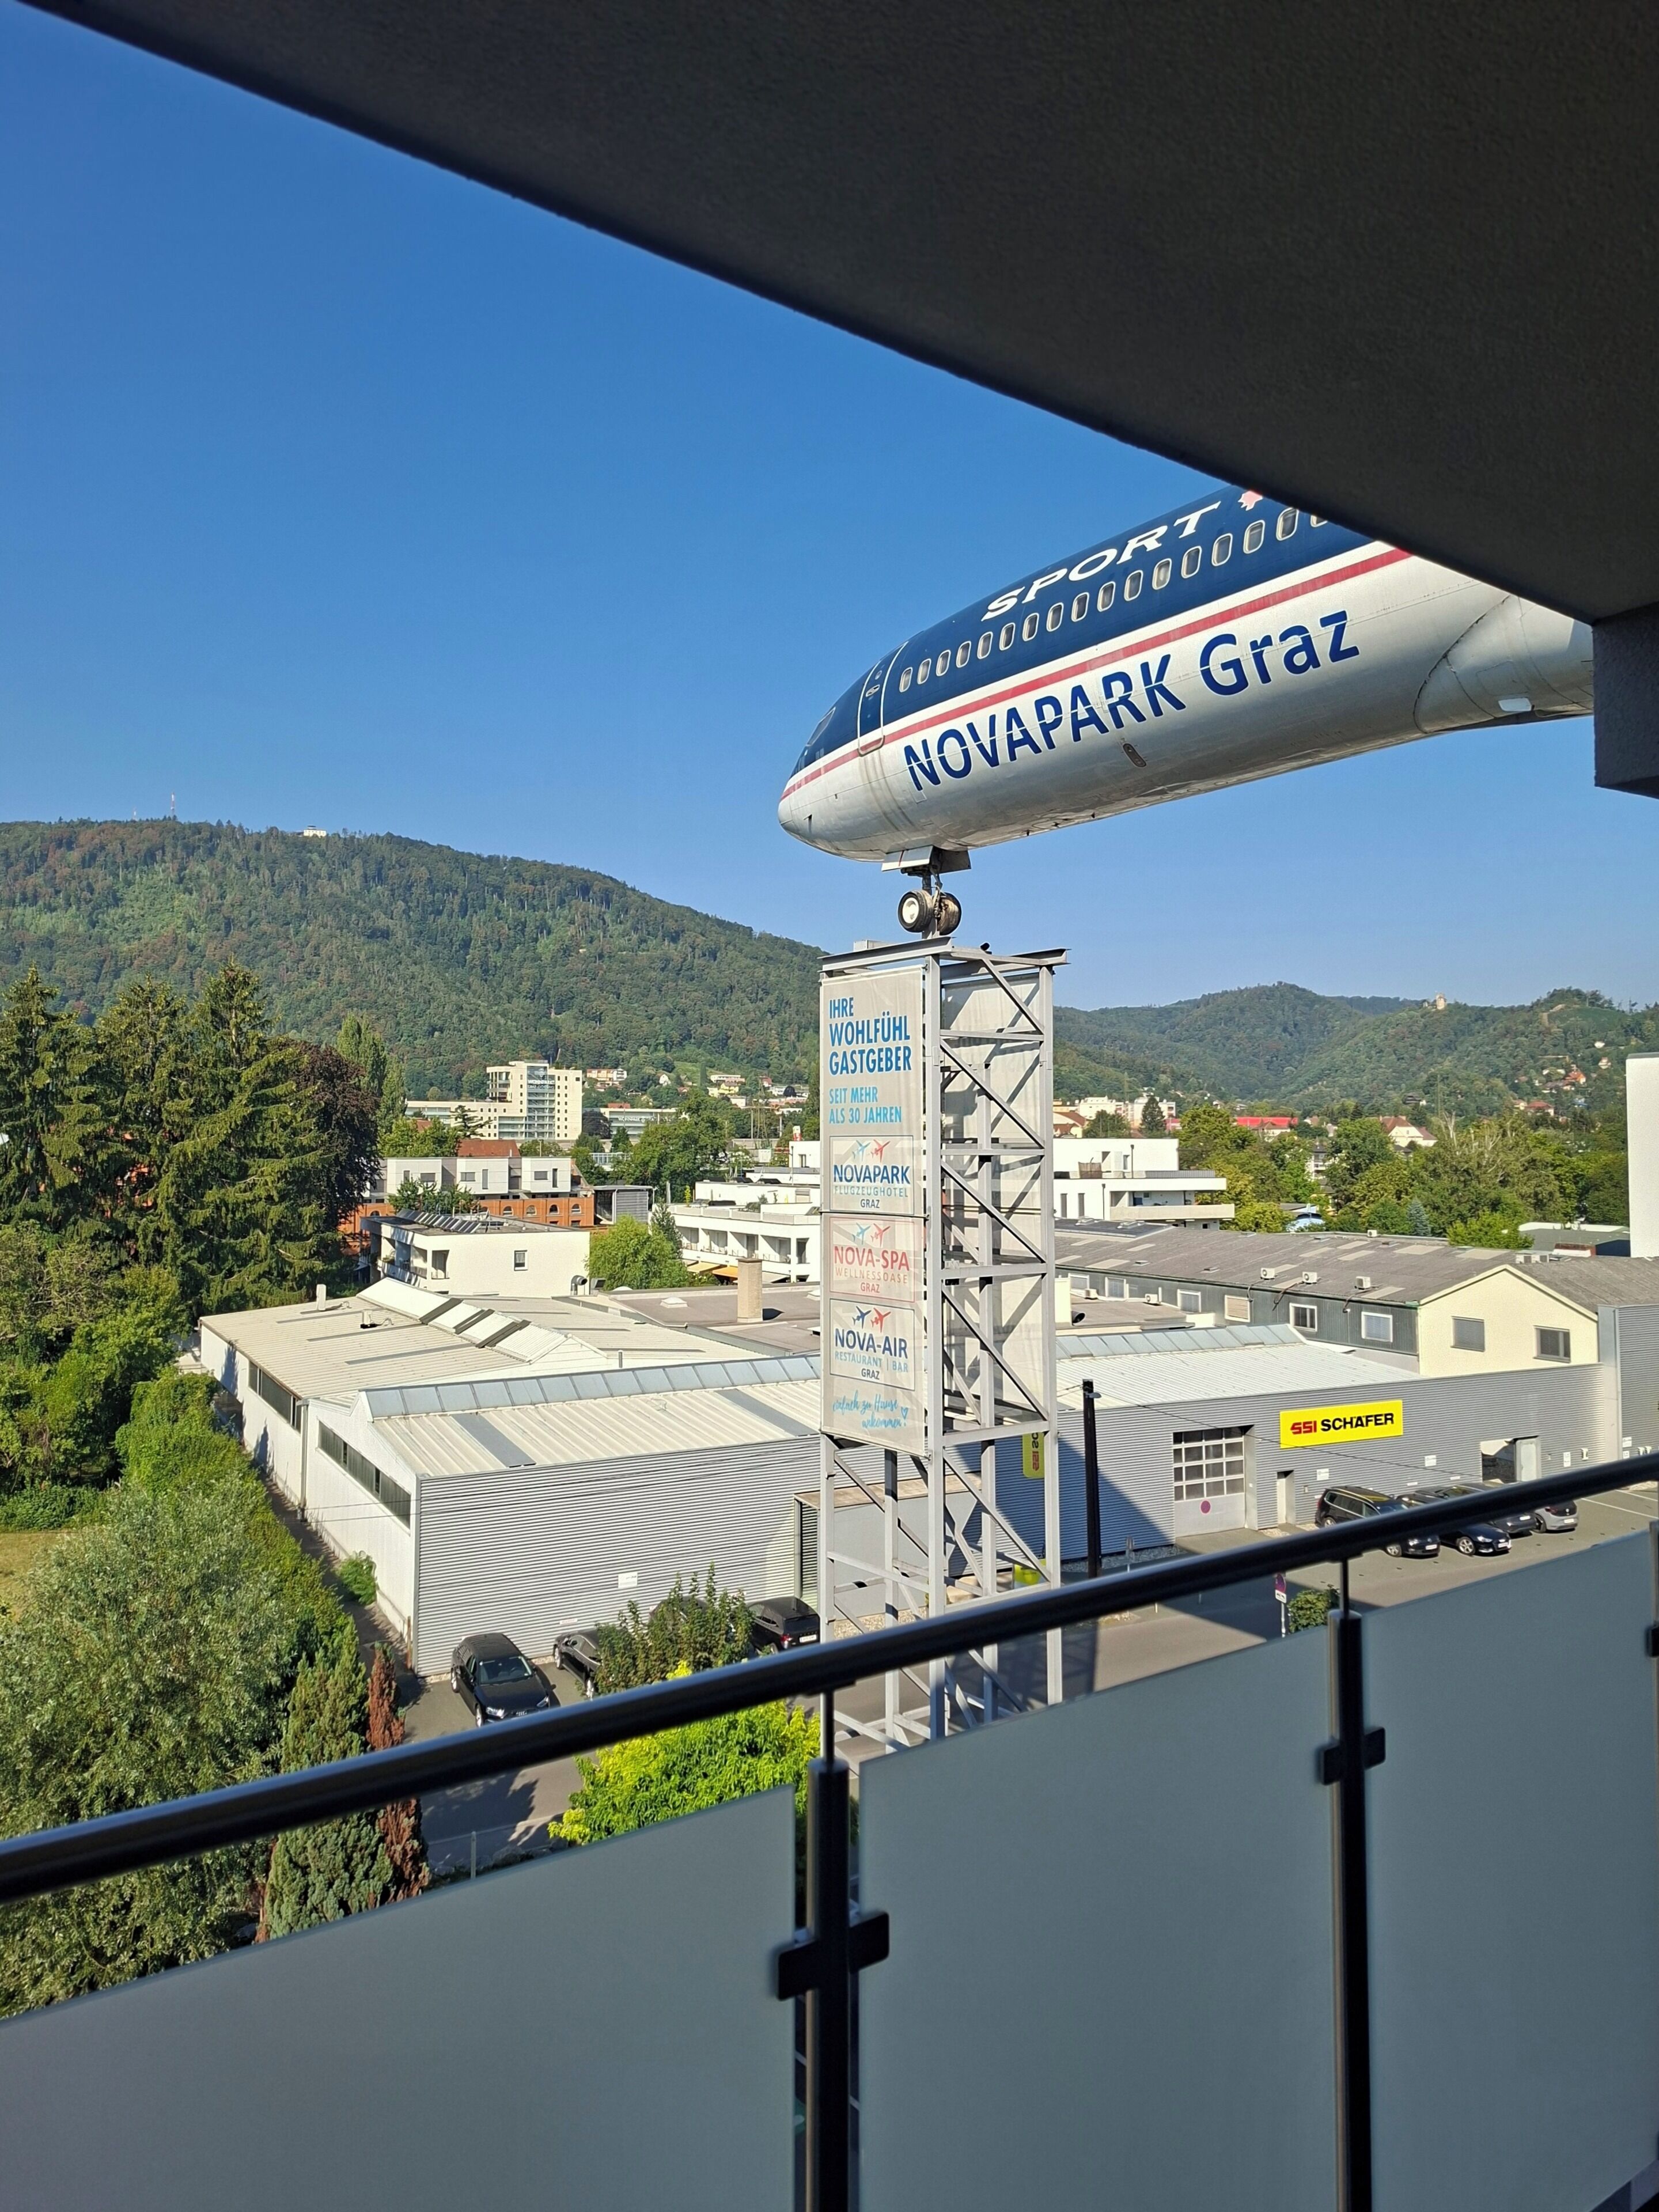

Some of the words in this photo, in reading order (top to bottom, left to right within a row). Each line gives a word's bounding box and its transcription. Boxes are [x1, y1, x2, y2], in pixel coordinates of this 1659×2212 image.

[981, 501, 1221, 622] SPORT
[904, 654, 1187, 791] NOVAPARK
[1200, 610, 1360, 695] Graz
[829, 997, 854, 1019] IHRE
[829, 1011, 910, 1047] WOHLFÜHL
[829, 1046, 911, 1075] GASTGEBER
[829, 1088, 847, 1104] SEIT
[850, 1086, 878, 1103] MEHR
[829, 1108, 845, 1124] ALS
[849, 1108, 860, 1123] 30
[863, 1107, 902, 1123] JAHREN
[834, 1165, 910, 1184] NOVAPARK
[834, 1185, 908, 1198] FLUGZEUGHOTEL
[860, 1199, 880, 1209] GRAZ
[834, 1246, 910, 1271] NOVA-SPA
[836, 1267, 908, 1284] WELLNESSOASE
[861, 1282, 880, 1293] GRAZ
[835, 1328, 908, 1359] NOVA-AIR
[835, 1351, 882, 1368] RESTAURANT
[892, 1361, 908, 1373] BAR
[861, 1368, 880, 1380] GRAZ
[1290, 1421, 1317, 1435] SSI
[1321, 1412, 1394, 1431] SCHÄFER
